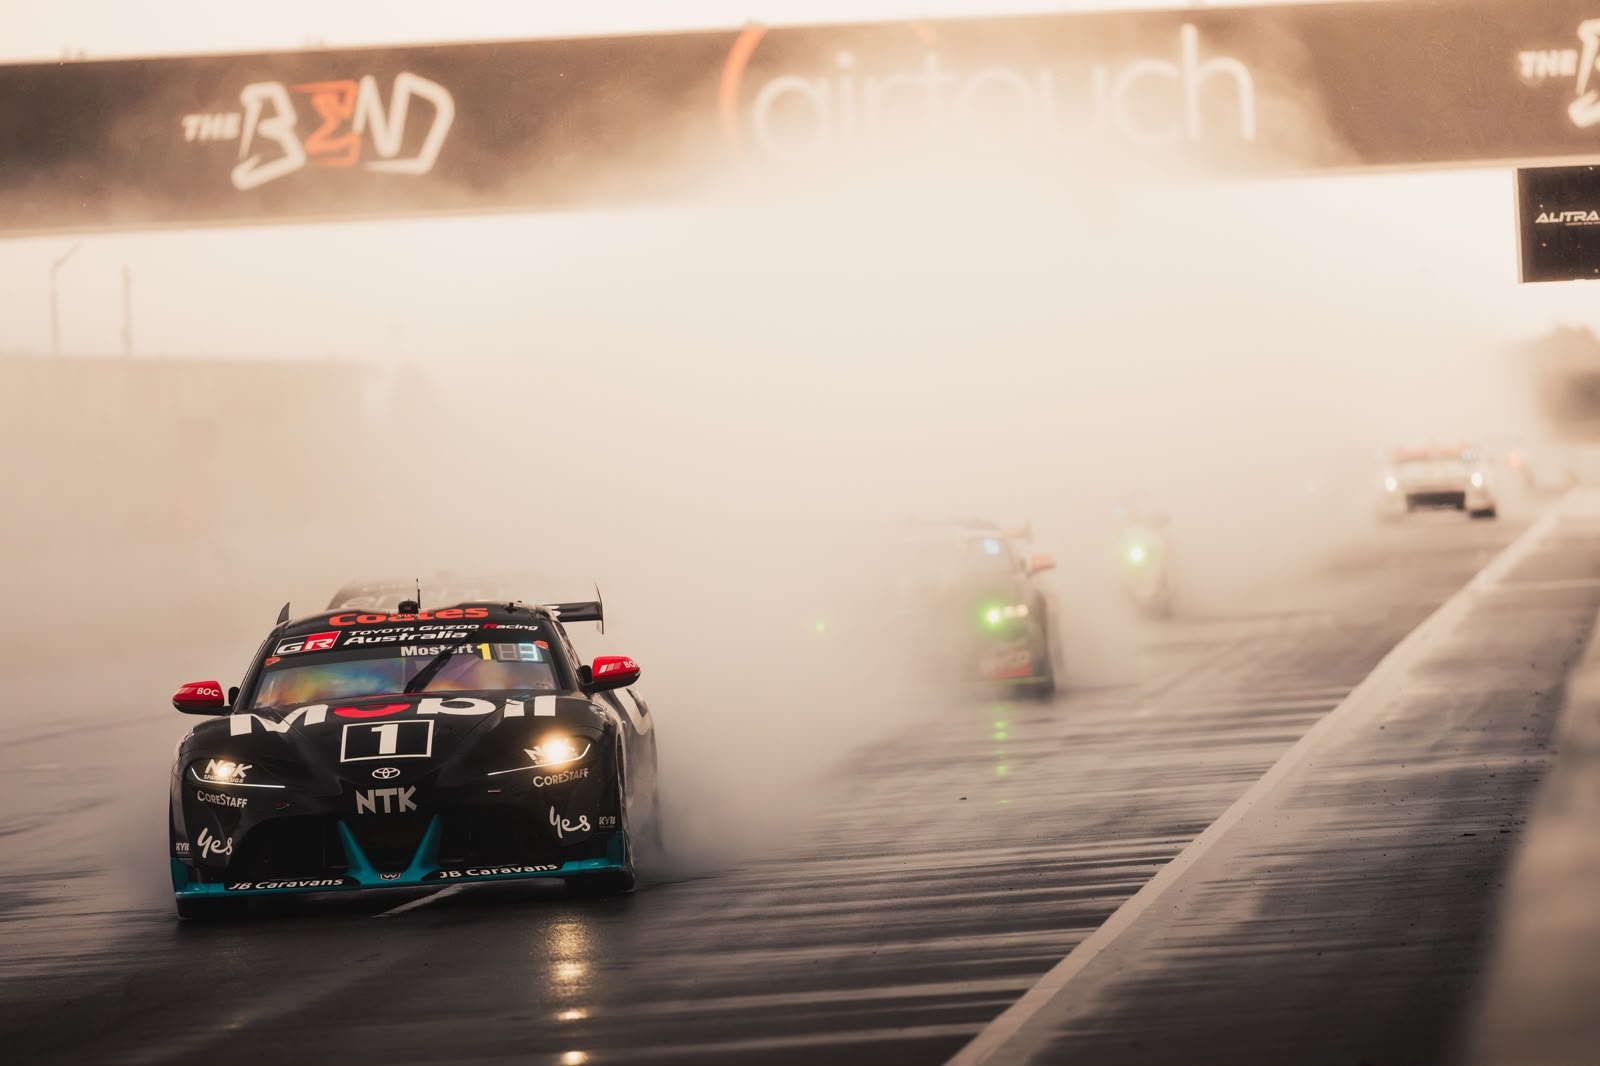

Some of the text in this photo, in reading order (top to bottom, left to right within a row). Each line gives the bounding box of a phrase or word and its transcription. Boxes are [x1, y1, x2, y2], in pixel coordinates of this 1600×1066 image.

[1517, 49, 1578, 78] THE
[751, 23, 1256, 160] airtouch
[181, 71, 456, 191] THE BEND
[328, 607, 488, 626] Coates
[343, 630, 468, 646] Australia
[348, 623, 540, 636] TOYOTA GAZOO Racing
[276, 637, 334, 656] GR
[476, 643, 492, 660] 1
[196, 687, 219, 697] BOC
[371, 723, 399, 755] 1
[355, 785, 418, 815] NTK
[439, 862, 558, 879] JB Caravans
[228, 877, 344, 890] JB Caravans
